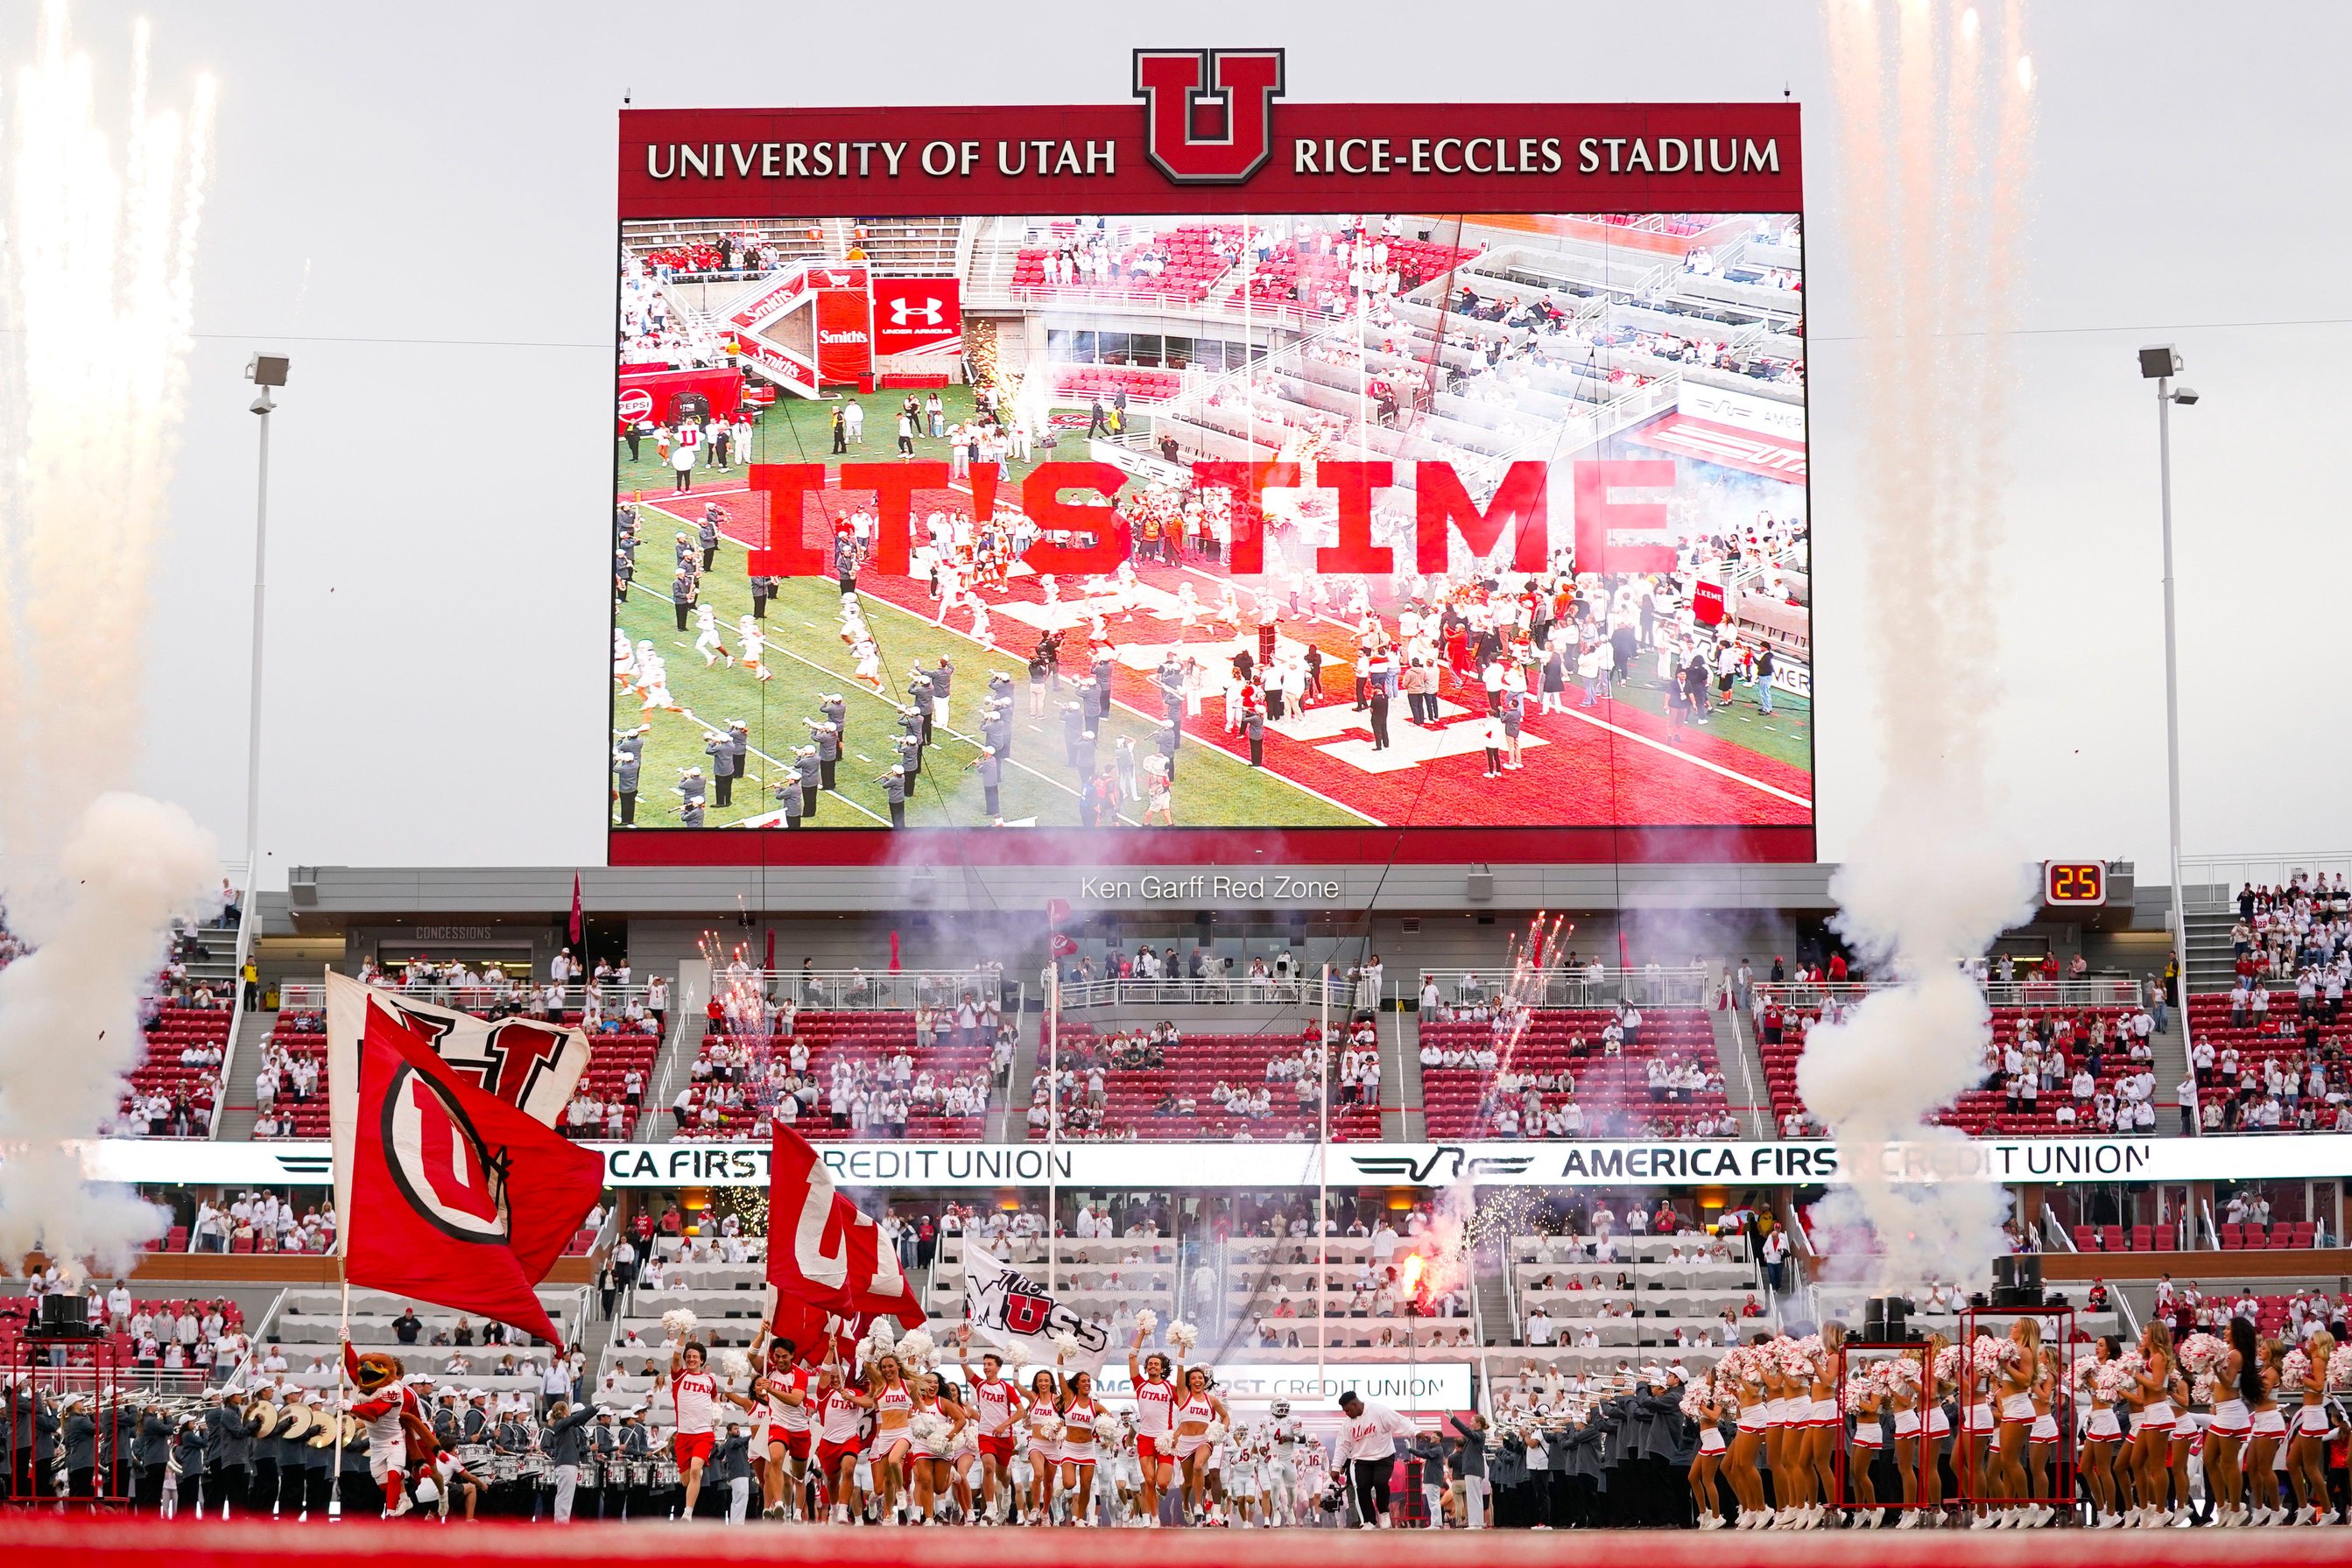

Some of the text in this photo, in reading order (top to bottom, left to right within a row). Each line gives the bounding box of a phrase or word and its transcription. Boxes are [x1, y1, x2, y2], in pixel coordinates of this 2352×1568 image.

[1132, 48, 1285, 185] U
[646, 139, 1116, 179] UNIVERSITY OF UTAH
[1293, 137, 1781, 175] RICE-ECCLES STADIUM
[743, 288, 795, 323] Smith's
[820, 329, 868, 344] Smith's
[618, 401, 650, 411] PEPSI
[1764, 411, 1803, 430] AMER
[681, 430, 697, 446] U
[748, 461, 1677, 576] IT'S TIME
[1695, 587, 1722, 602] LKEME
[1772, 667, 1810, 692] MER
[1081, 875, 1339, 899] Ken Garff Red Zone
[2056, 868, 2096, 897] 25
[416, 926, 491, 939] CONCESSIONS
[668, 1150, 771, 1179] FIRST
[824, 1150, 938, 1179] REDIT
[947, 1150, 1072, 1179] UNION
[1561, 1147, 1741, 1178] AMERICA
[2027, 1144, 2151, 1174] UNION
[998, 1269, 1043, 1295] The
[967, 1276, 1108, 1353] MUSS
[683, 1381, 711, 1395] UTAH
[981, 1389, 1005, 1403] UTAH
[1141, 1390, 1169, 1402] UTAH
[1367, 1378, 1444, 1397] UNION
[831, 1398, 857, 1410] UTAH
[885, 1394, 906, 1403] UTAH
[1034, 1408, 1053, 1417] UTAH
[1071, 1412, 1091, 1423] UTAH
[1190, 1407, 1208, 1416] UTAH
[1274, 1428, 1284, 1445] 4
[1352, 1423, 1377, 1442] Utah
[1309, 1454, 1320, 1466] 16
